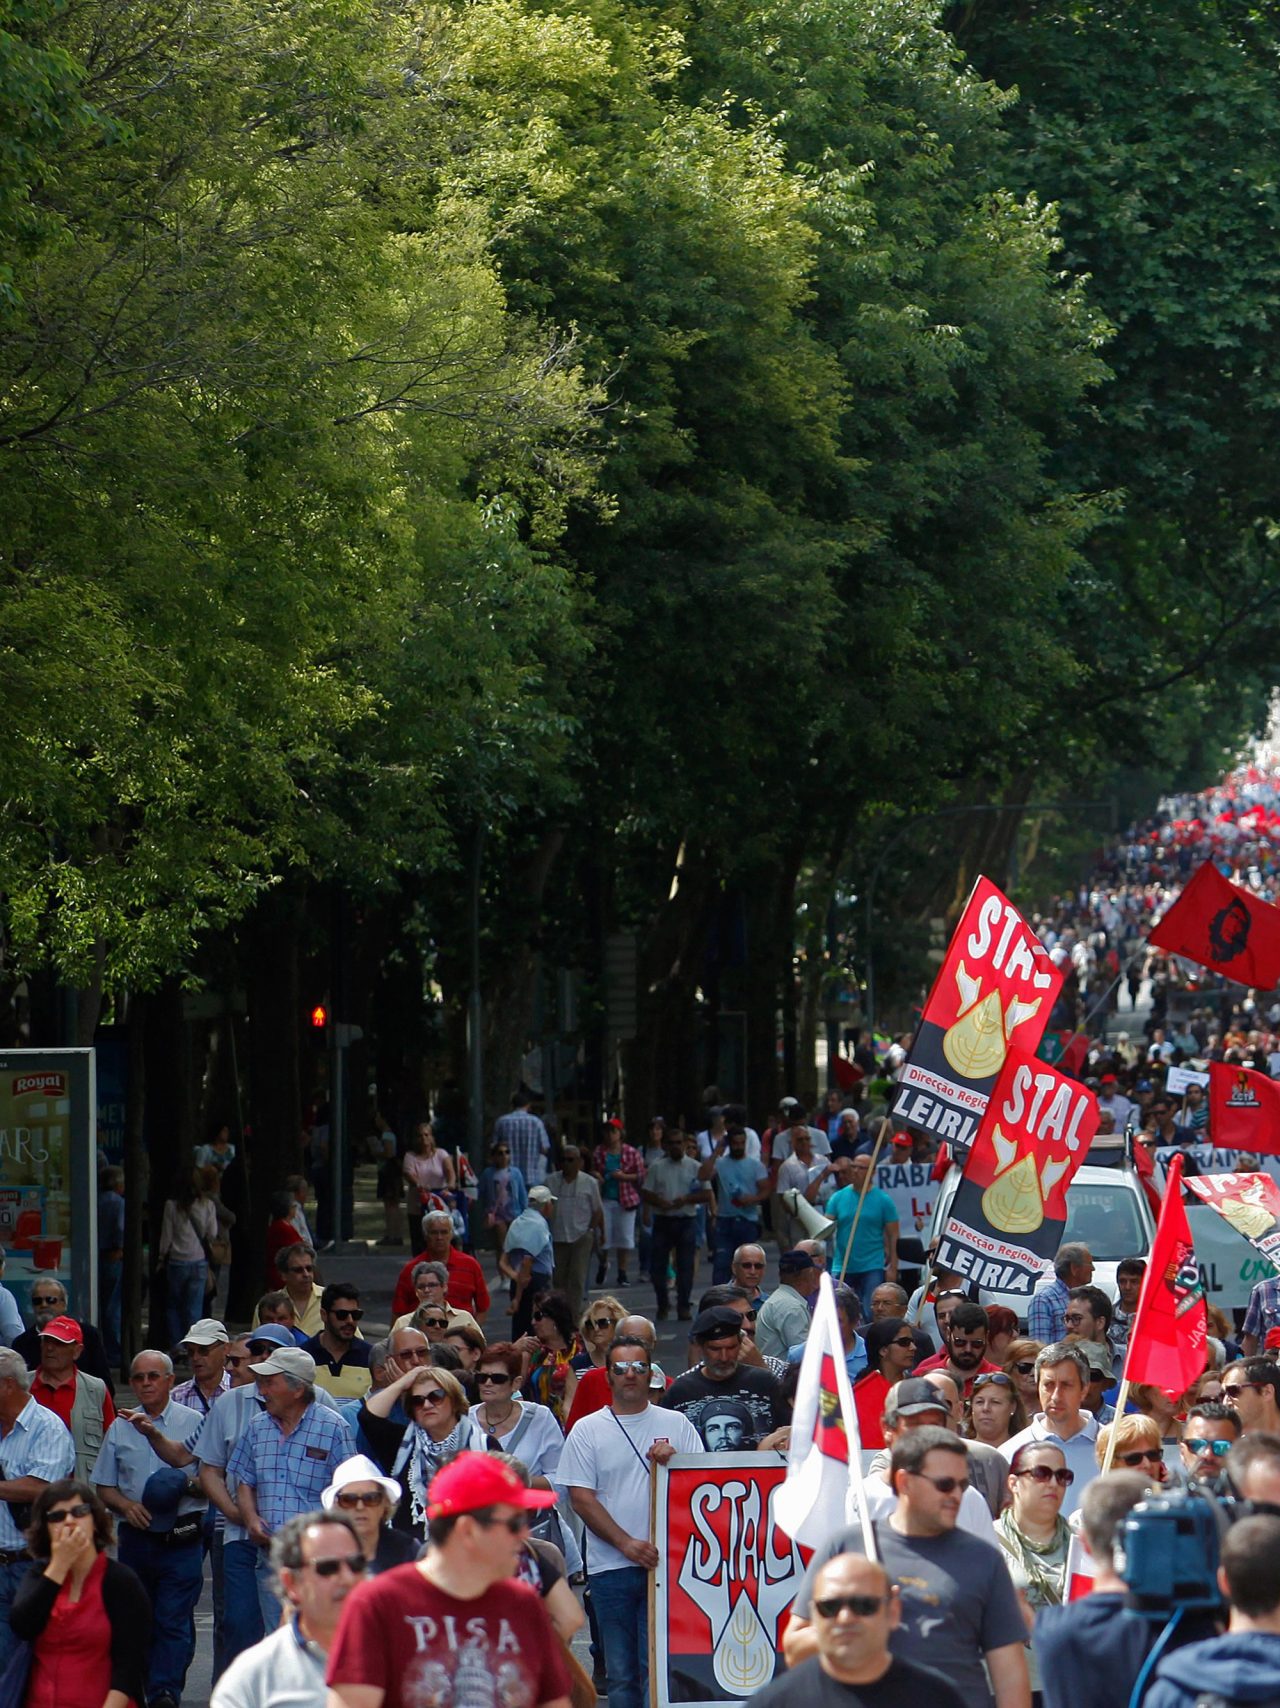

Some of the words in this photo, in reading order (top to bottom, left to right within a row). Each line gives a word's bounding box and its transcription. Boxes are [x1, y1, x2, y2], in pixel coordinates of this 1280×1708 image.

[17, 1074, 60, 1092] Royal
[1003, 1065, 1088, 1151] STAL
[950, 1221, 996, 1252] Direcção
[936, 1240, 1030, 1293] LEIRIA
[690, 1479, 793, 1581] STAL
[404, 1615, 521, 1654] PISA
